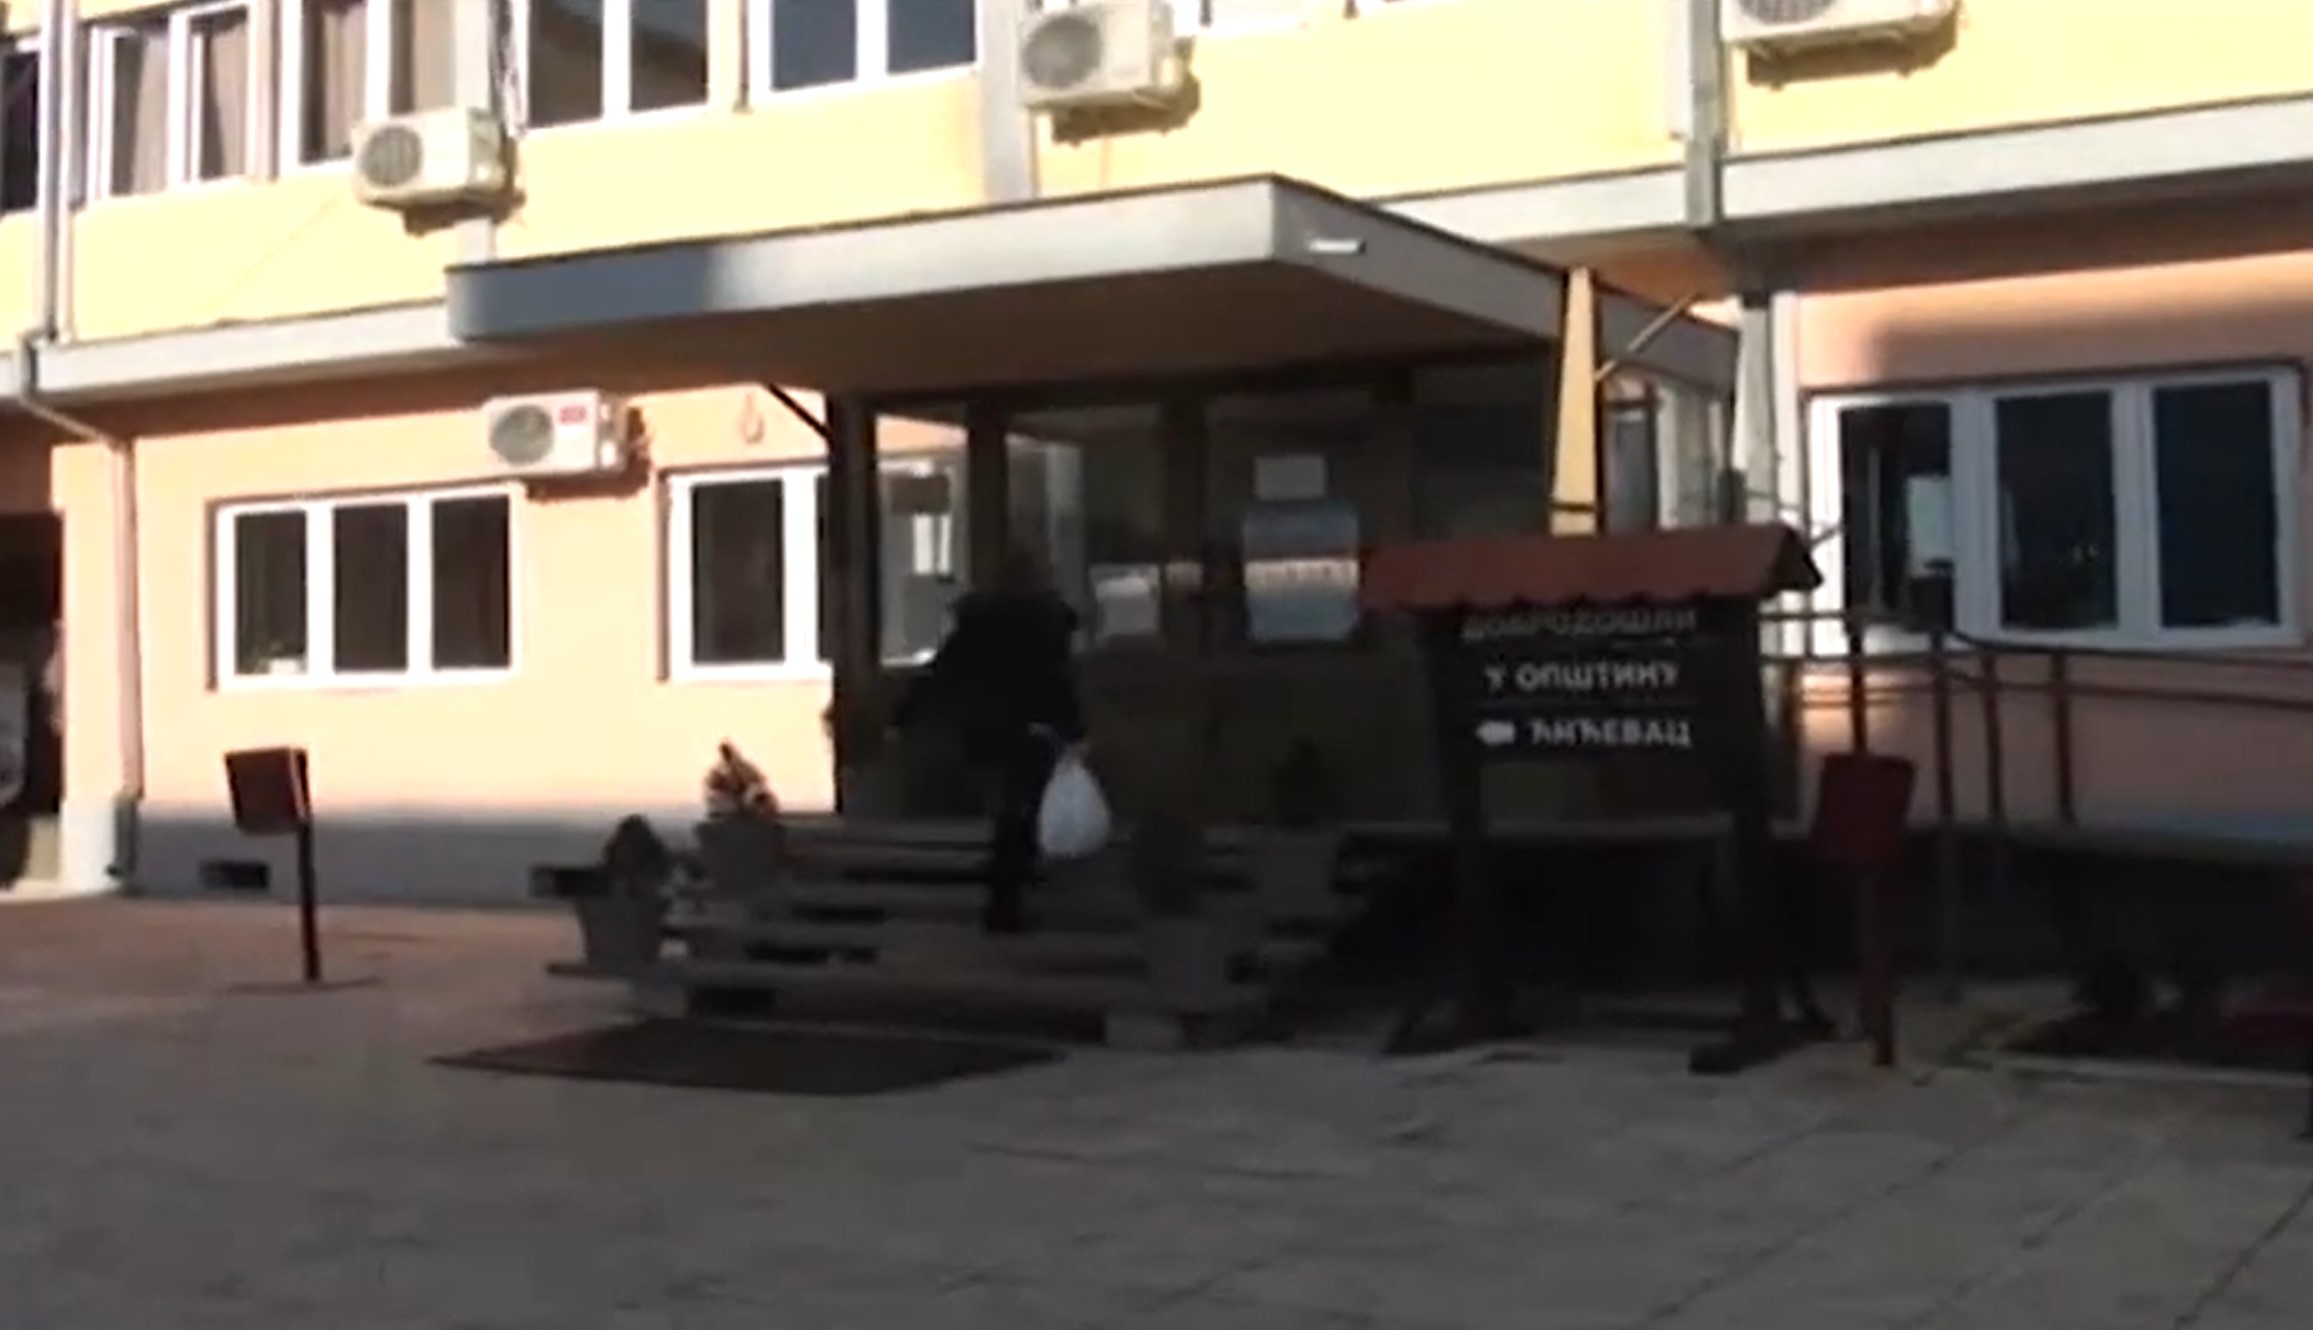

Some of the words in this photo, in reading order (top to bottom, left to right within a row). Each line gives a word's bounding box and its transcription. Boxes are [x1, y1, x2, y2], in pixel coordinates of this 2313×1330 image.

[1485, 664, 1506, 691] У
[1515, 662, 1679, 691] ОПШТИНУ
[1530, 718, 1692, 748] ЋИЋЕВАЦ
